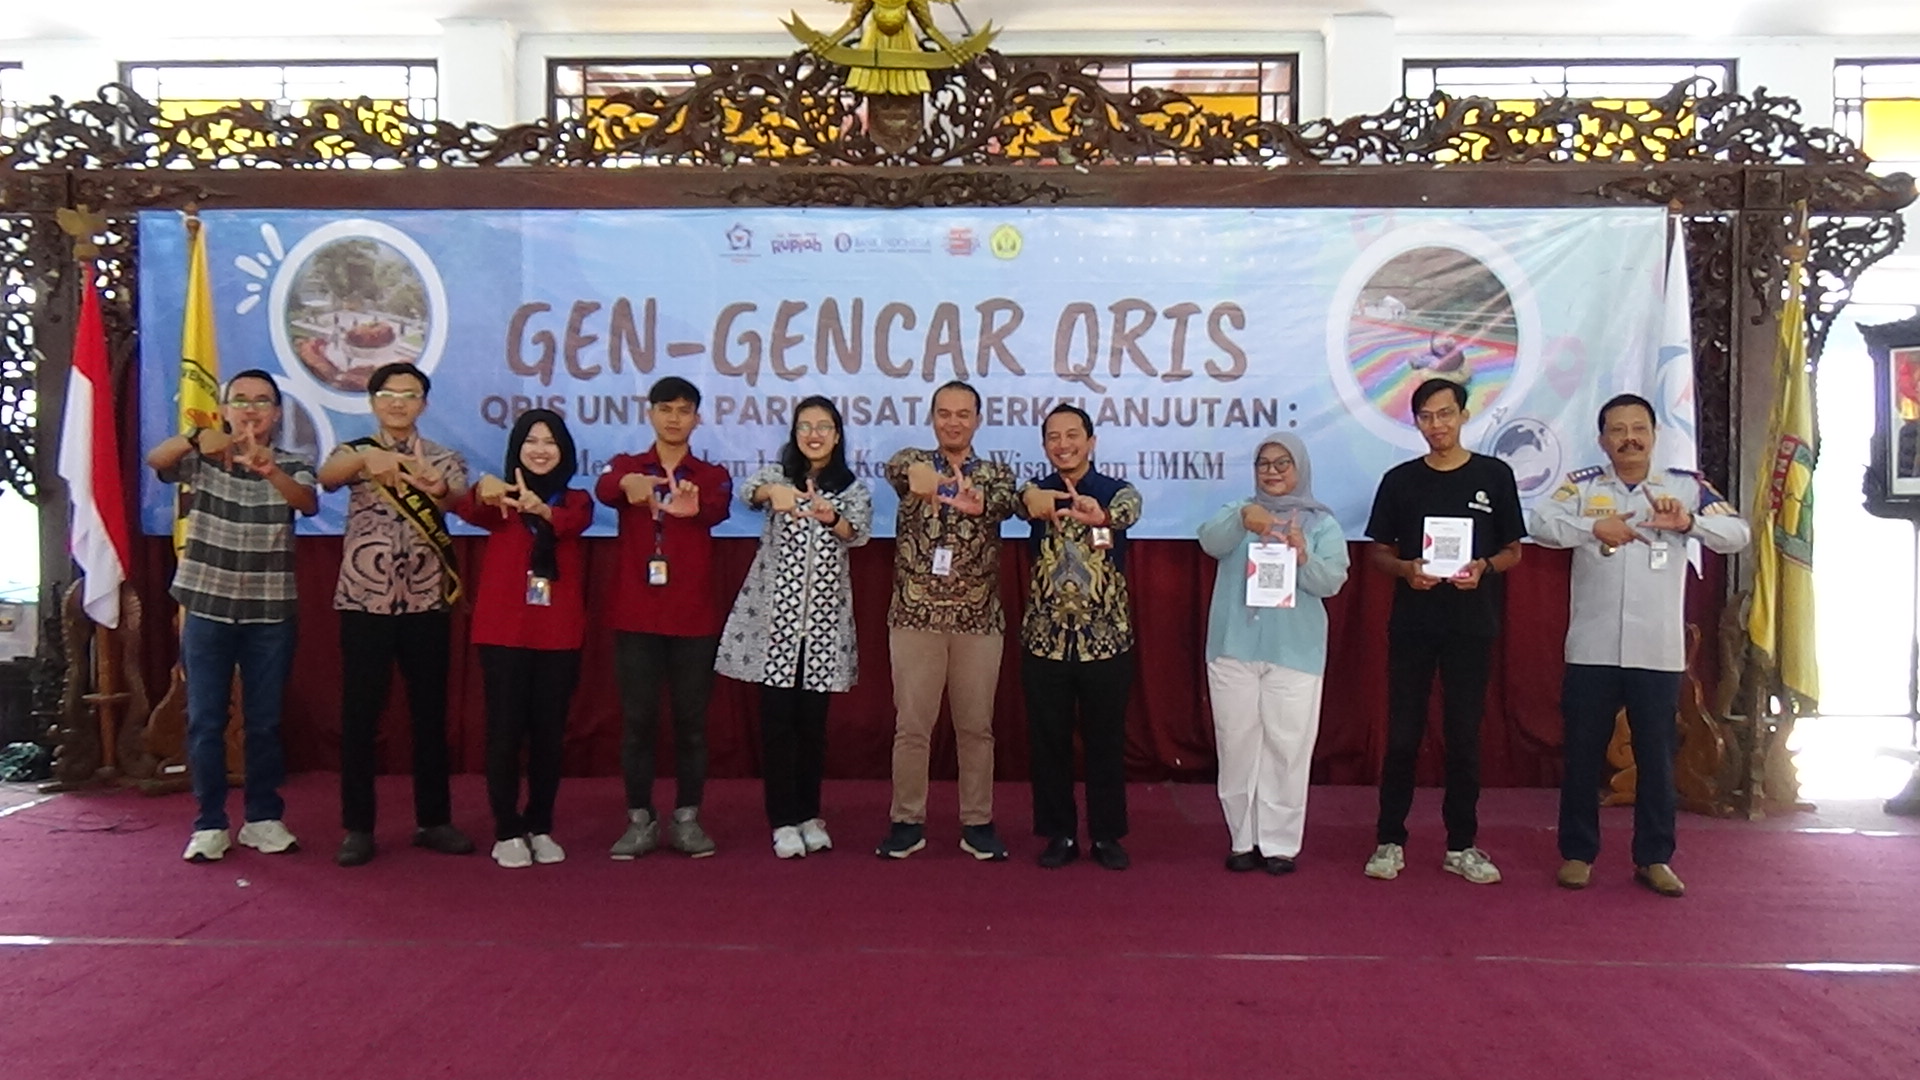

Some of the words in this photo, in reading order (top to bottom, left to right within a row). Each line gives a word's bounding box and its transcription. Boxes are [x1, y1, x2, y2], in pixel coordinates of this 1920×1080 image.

[505, 297, 1026, 387] GEN-GENCAR
[1053, 298, 1248, 394] QRIS
[577, 395, 704, 426] UNT
[715, 395, 933, 427] PARIISAT
[1138, 451, 1226, 481] UMKM
